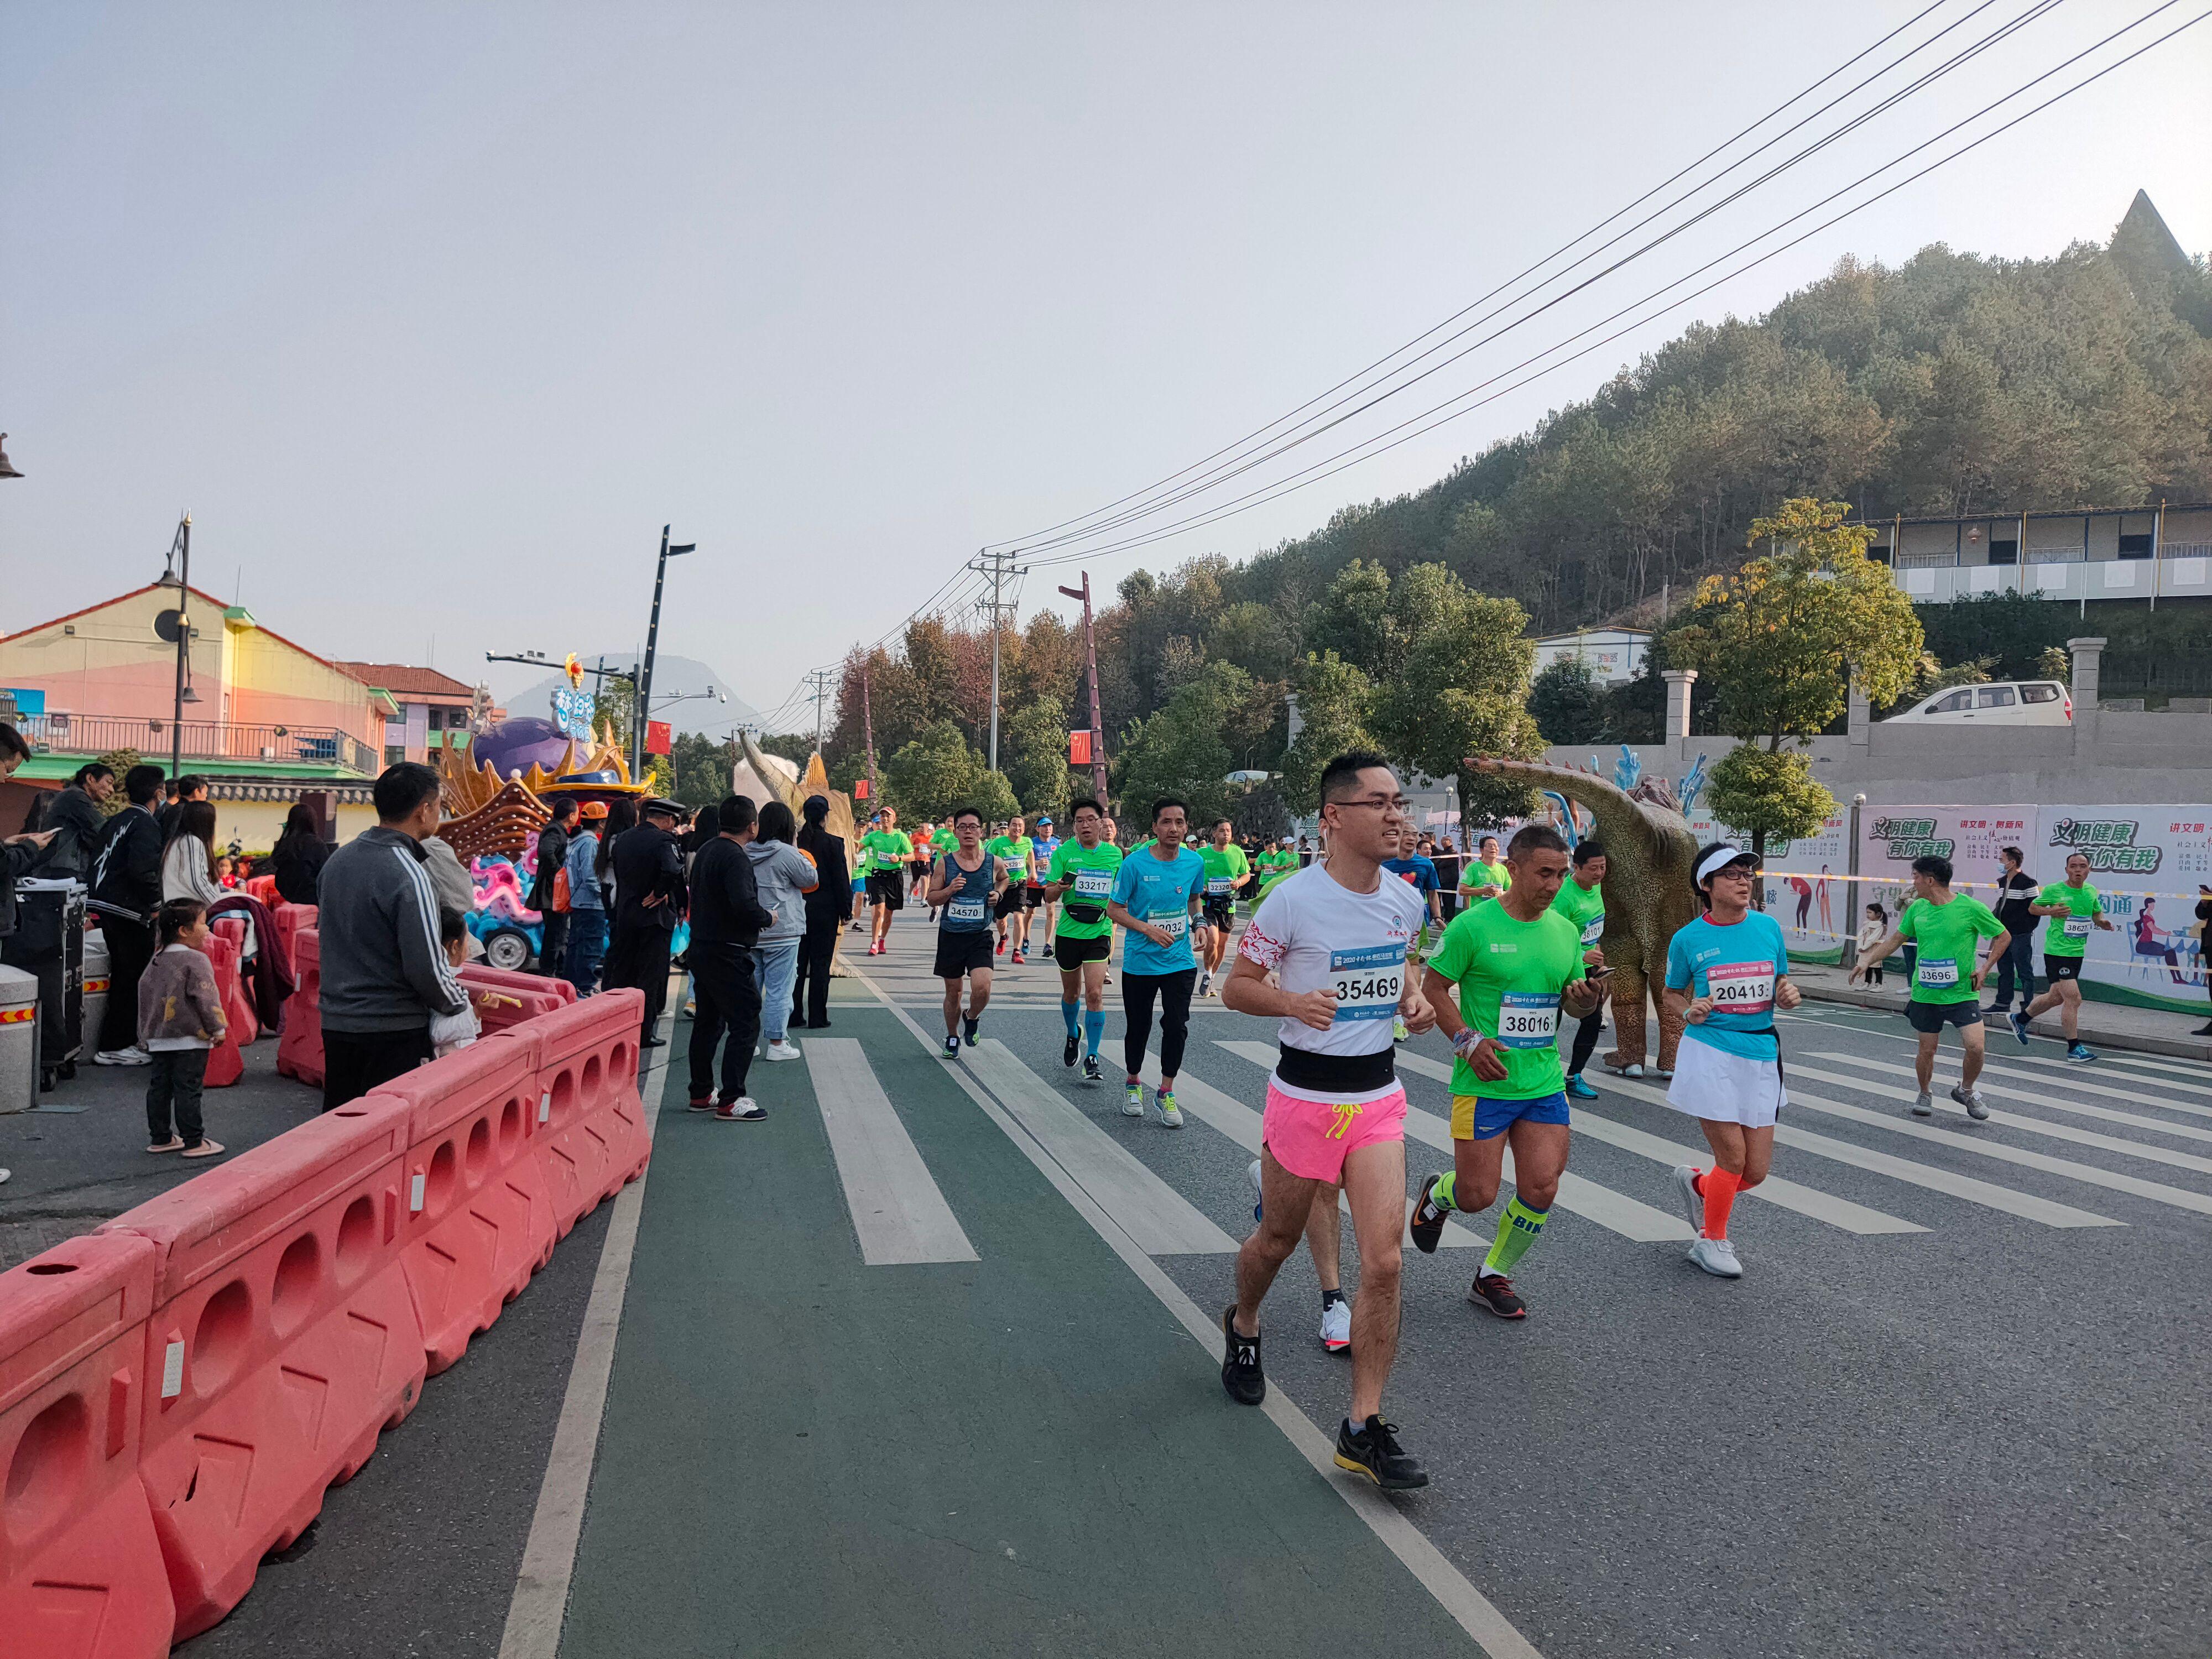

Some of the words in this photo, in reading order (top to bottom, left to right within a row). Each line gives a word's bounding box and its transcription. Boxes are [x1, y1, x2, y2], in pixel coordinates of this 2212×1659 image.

[1871, 817, 1934, 838] 文明健康
[2053, 819, 2133, 843] 文明健康
[1889, 839, 1951, 858] 有你有我
[1078, 881, 1107, 891] 33217
[951, 907, 978, 916] 34570
[1921, 971, 1952, 980] 33696
[1336, 977, 1399, 1001] 35469
[1716, 984, 1764, 1000] 20413
[1506, 1016, 1550, 1032] 38016
